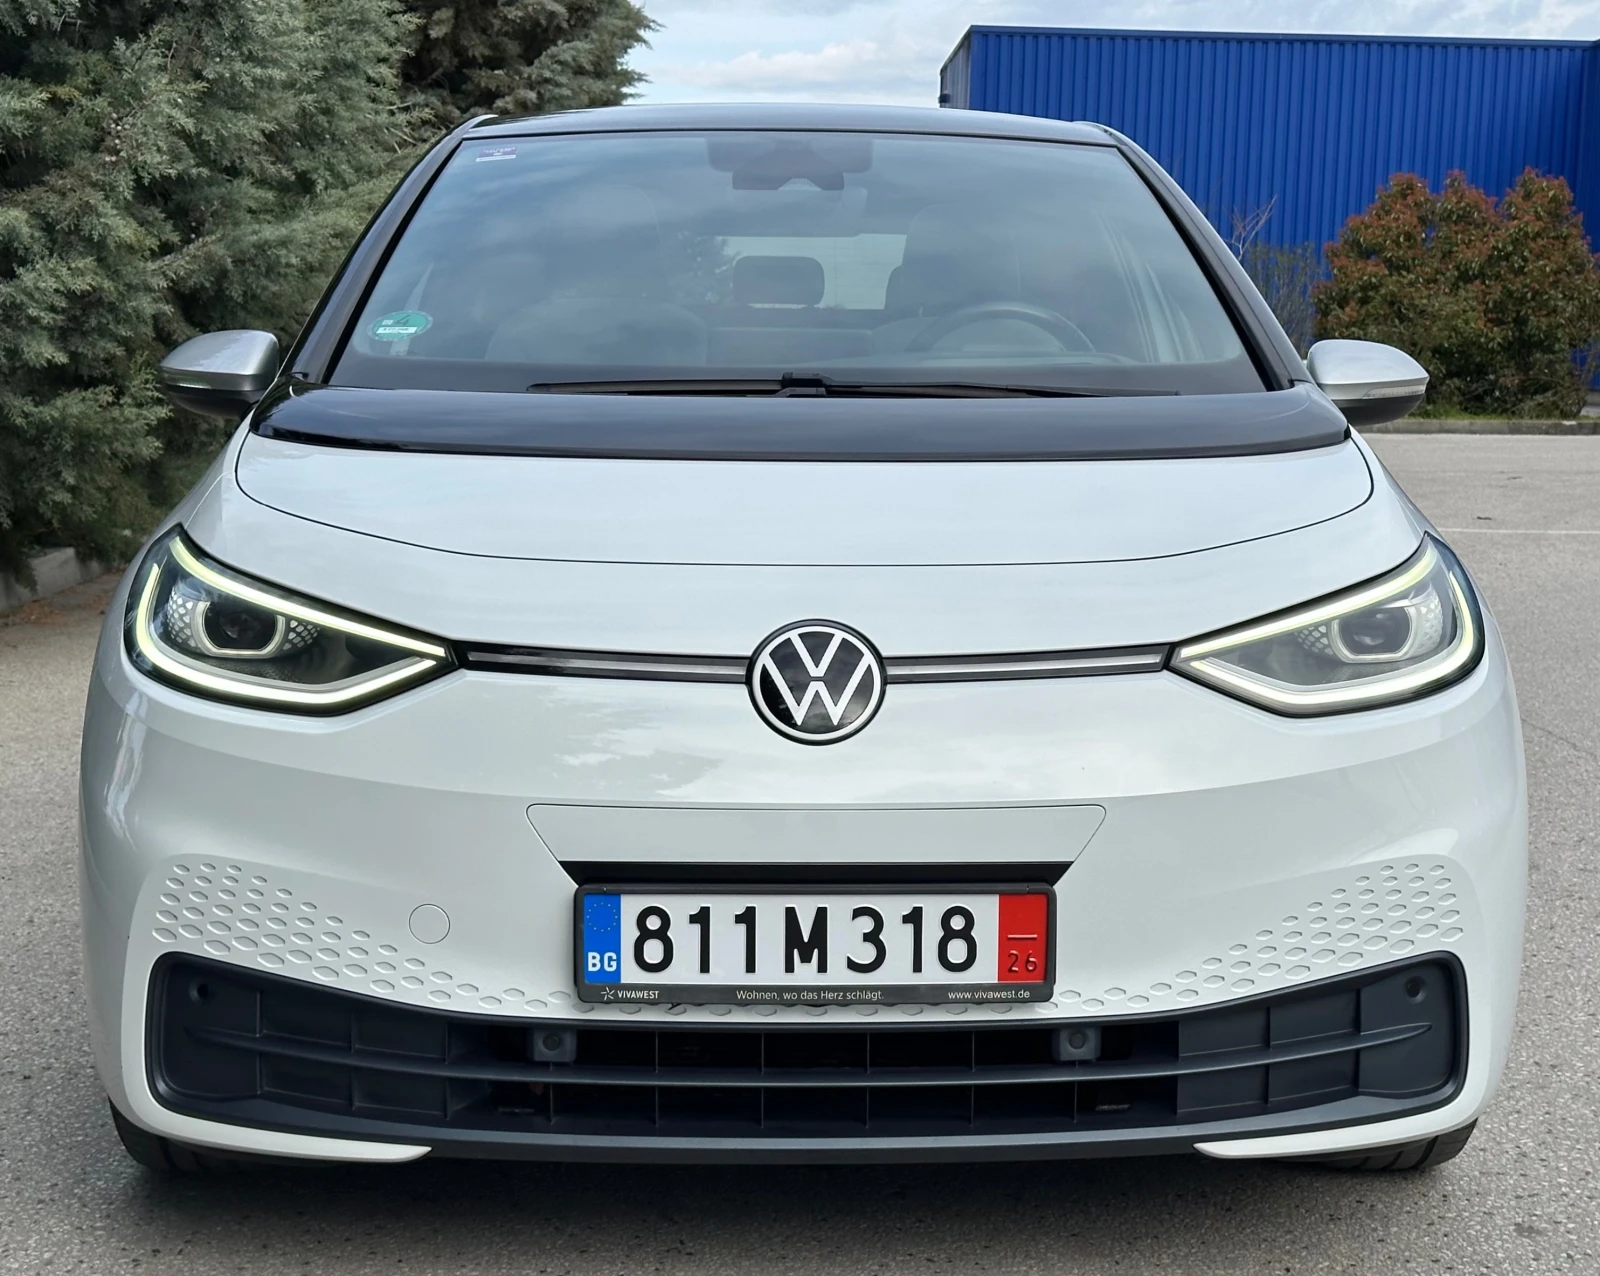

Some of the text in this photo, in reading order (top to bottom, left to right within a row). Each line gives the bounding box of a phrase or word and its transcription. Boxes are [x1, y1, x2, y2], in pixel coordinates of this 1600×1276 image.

[587, 952, 617, 972] BG
[1007, 950, 1038, 973] 26
[617, 990, 660, 999] VIVAWEST
[736, 990, 884, 1002] Wohnen, wo das Herz schlägt.
[948, 989, 1031, 1000] www.vivawest.de
